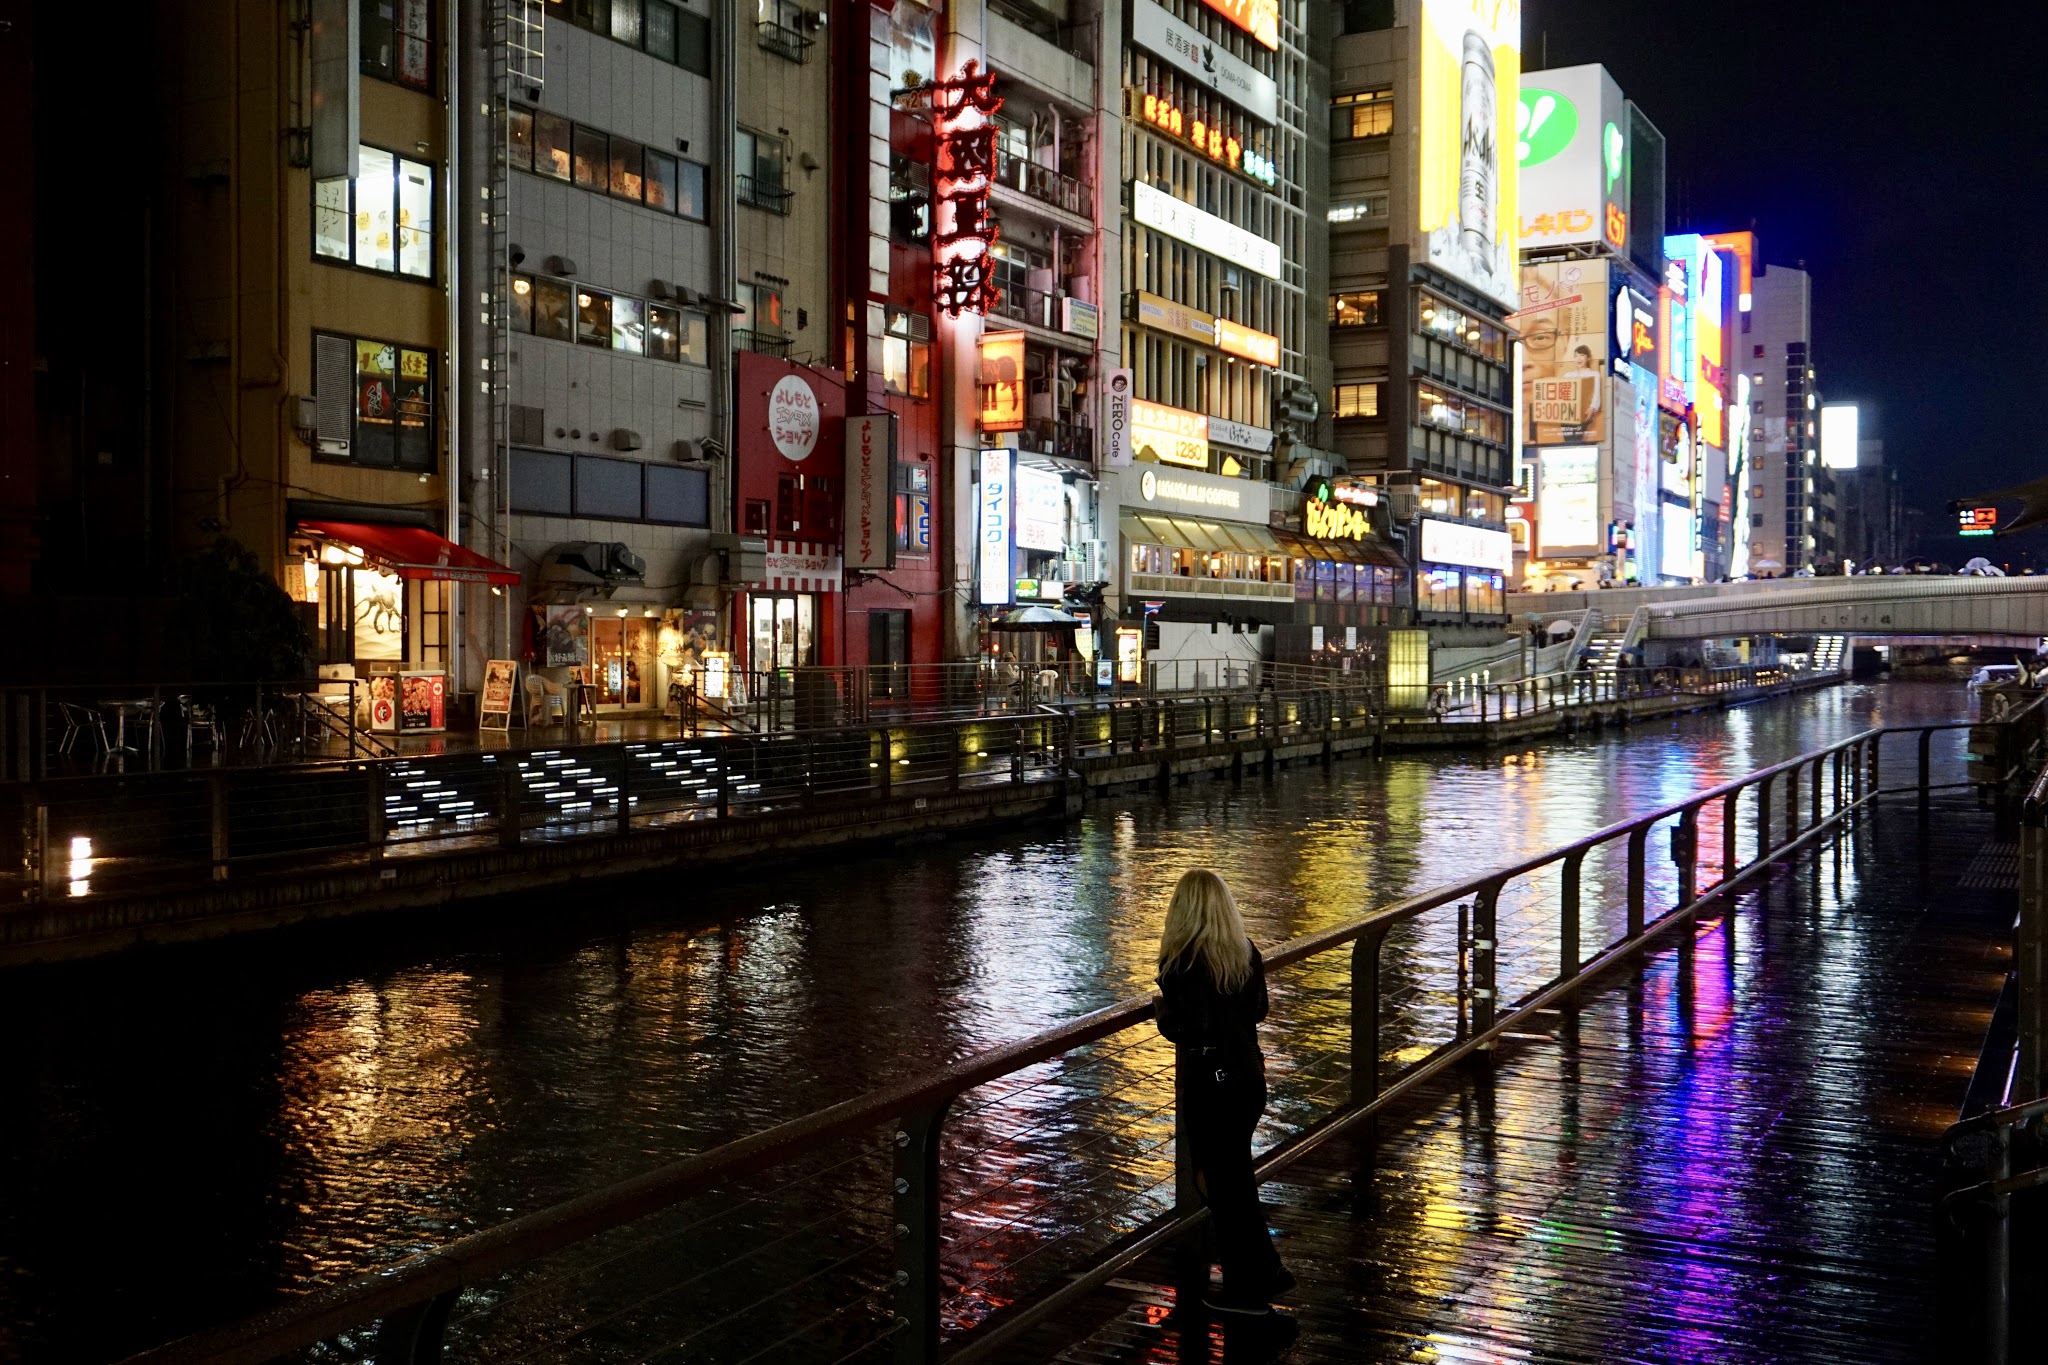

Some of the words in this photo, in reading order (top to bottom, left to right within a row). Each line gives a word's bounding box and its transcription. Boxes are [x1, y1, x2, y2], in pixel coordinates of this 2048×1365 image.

[1463, 112, 1496, 176] Asahi
[1153, 194, 1196, 240] 白木屋
[1228, 229, 1265, 269] 白木屋
[776, 388, 812, 409] よしもと
[1112, 395, 1124, 431] ZERO
[776, 406, 813, 427] エンタメ
[776, 429, 813, 447] ショップ
[1180, 441, 1202, 461] 280
[860, 419, 872, 562] よしもとエンタメショップ
[1157, 479, 1206, 503] HONOLULU
[1206, 487, 1240, 508] COFFEE
